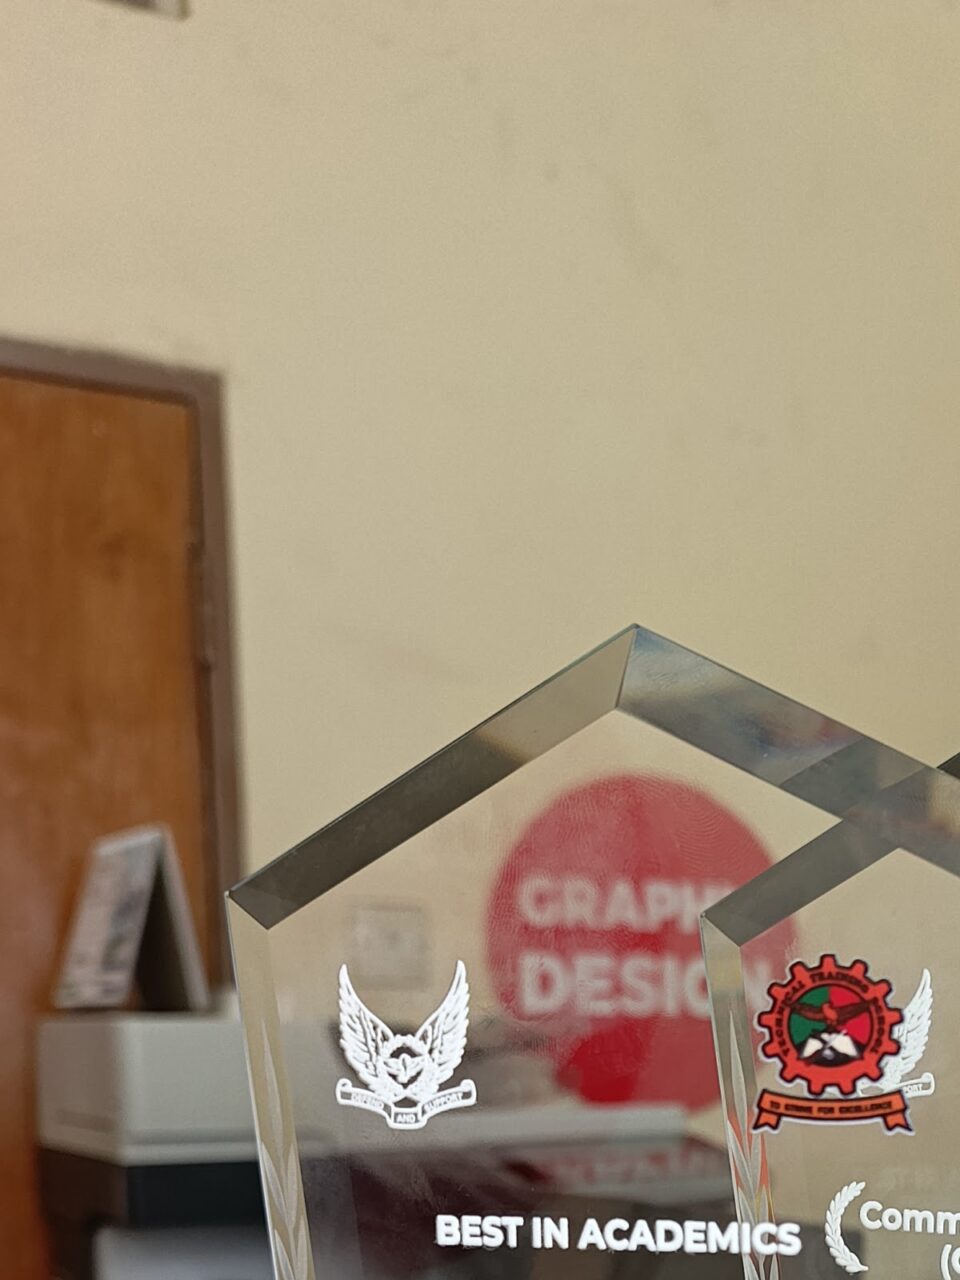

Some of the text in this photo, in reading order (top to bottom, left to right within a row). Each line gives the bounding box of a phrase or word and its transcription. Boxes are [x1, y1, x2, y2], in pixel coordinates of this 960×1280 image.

[435, 1215, 801, 1257] BEST IN ACADEMICS
